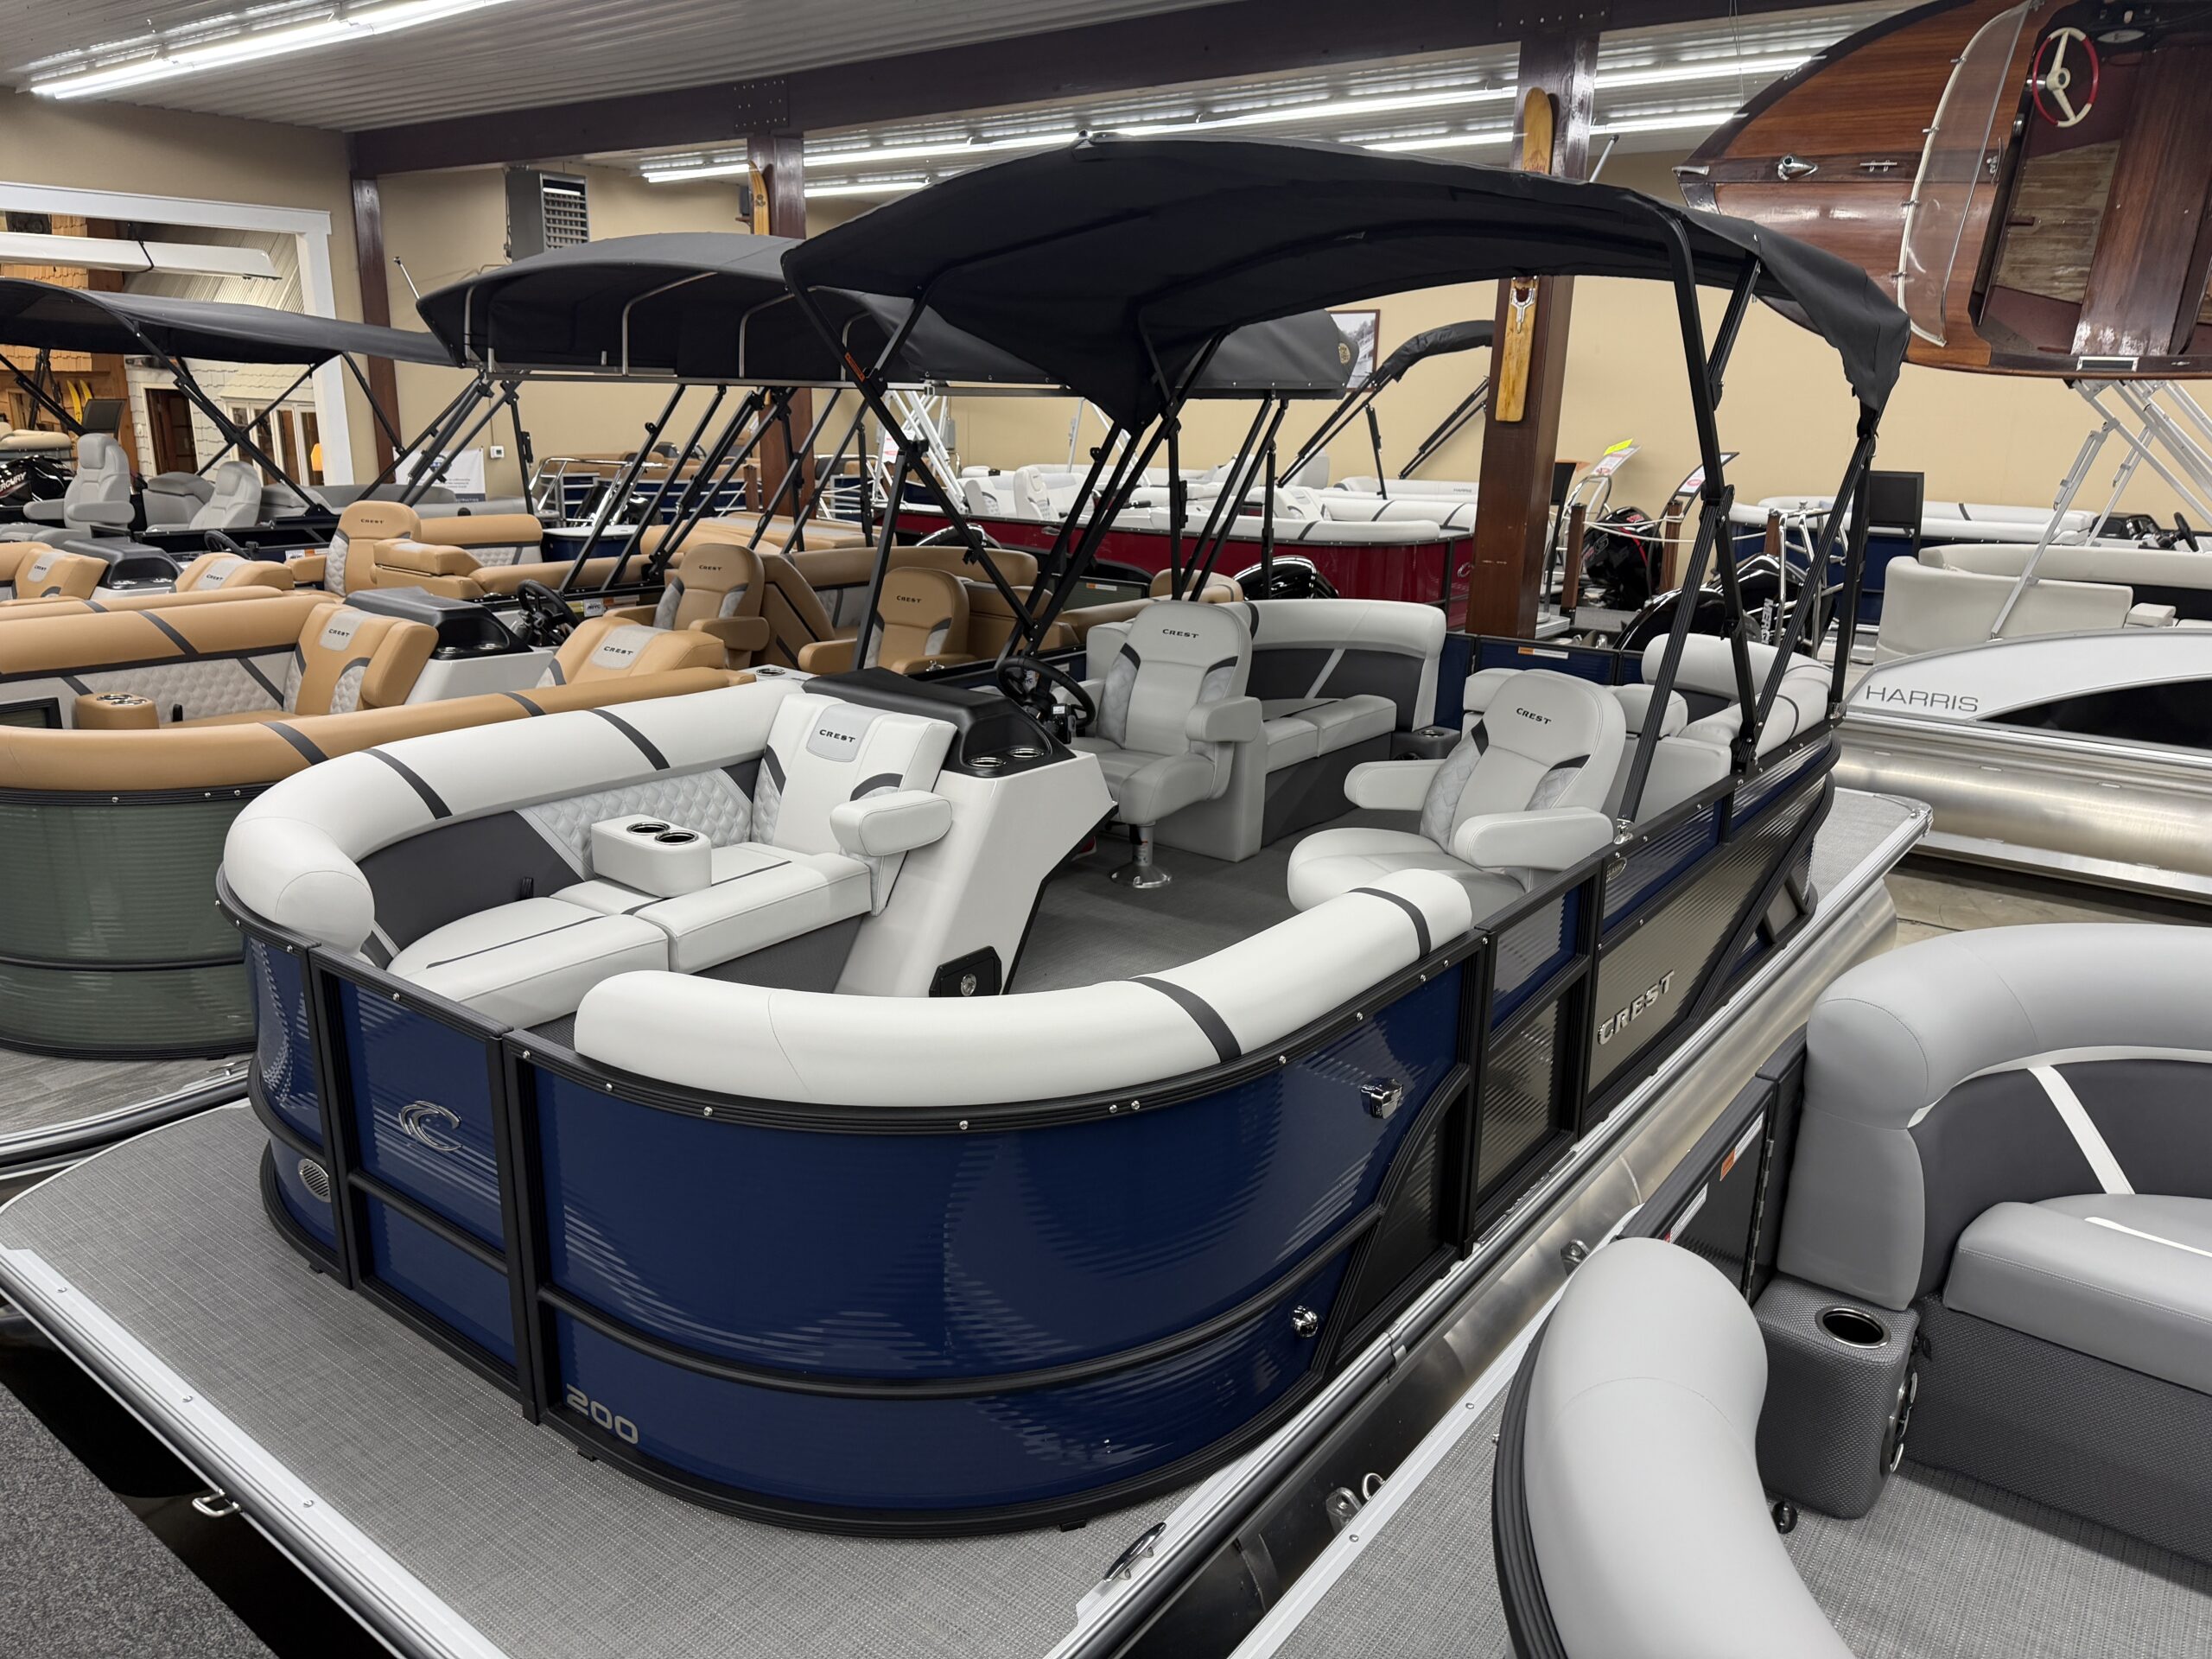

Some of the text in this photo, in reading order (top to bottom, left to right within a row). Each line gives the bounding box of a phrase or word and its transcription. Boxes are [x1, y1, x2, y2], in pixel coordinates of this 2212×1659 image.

[0, 471, 27, 492] RCURY
[1162, 628, 1199, 639] CREST
[603, 645, 633, 655] CREST
[1866, 685, 1979, 713] HARRIS
[1516, 707, 1552, 724] CREST
[819, 728, 856, 743] CREST
[1597, 969, 1675, 1046] CREST
[566, 1382, 639, 1445] 200
